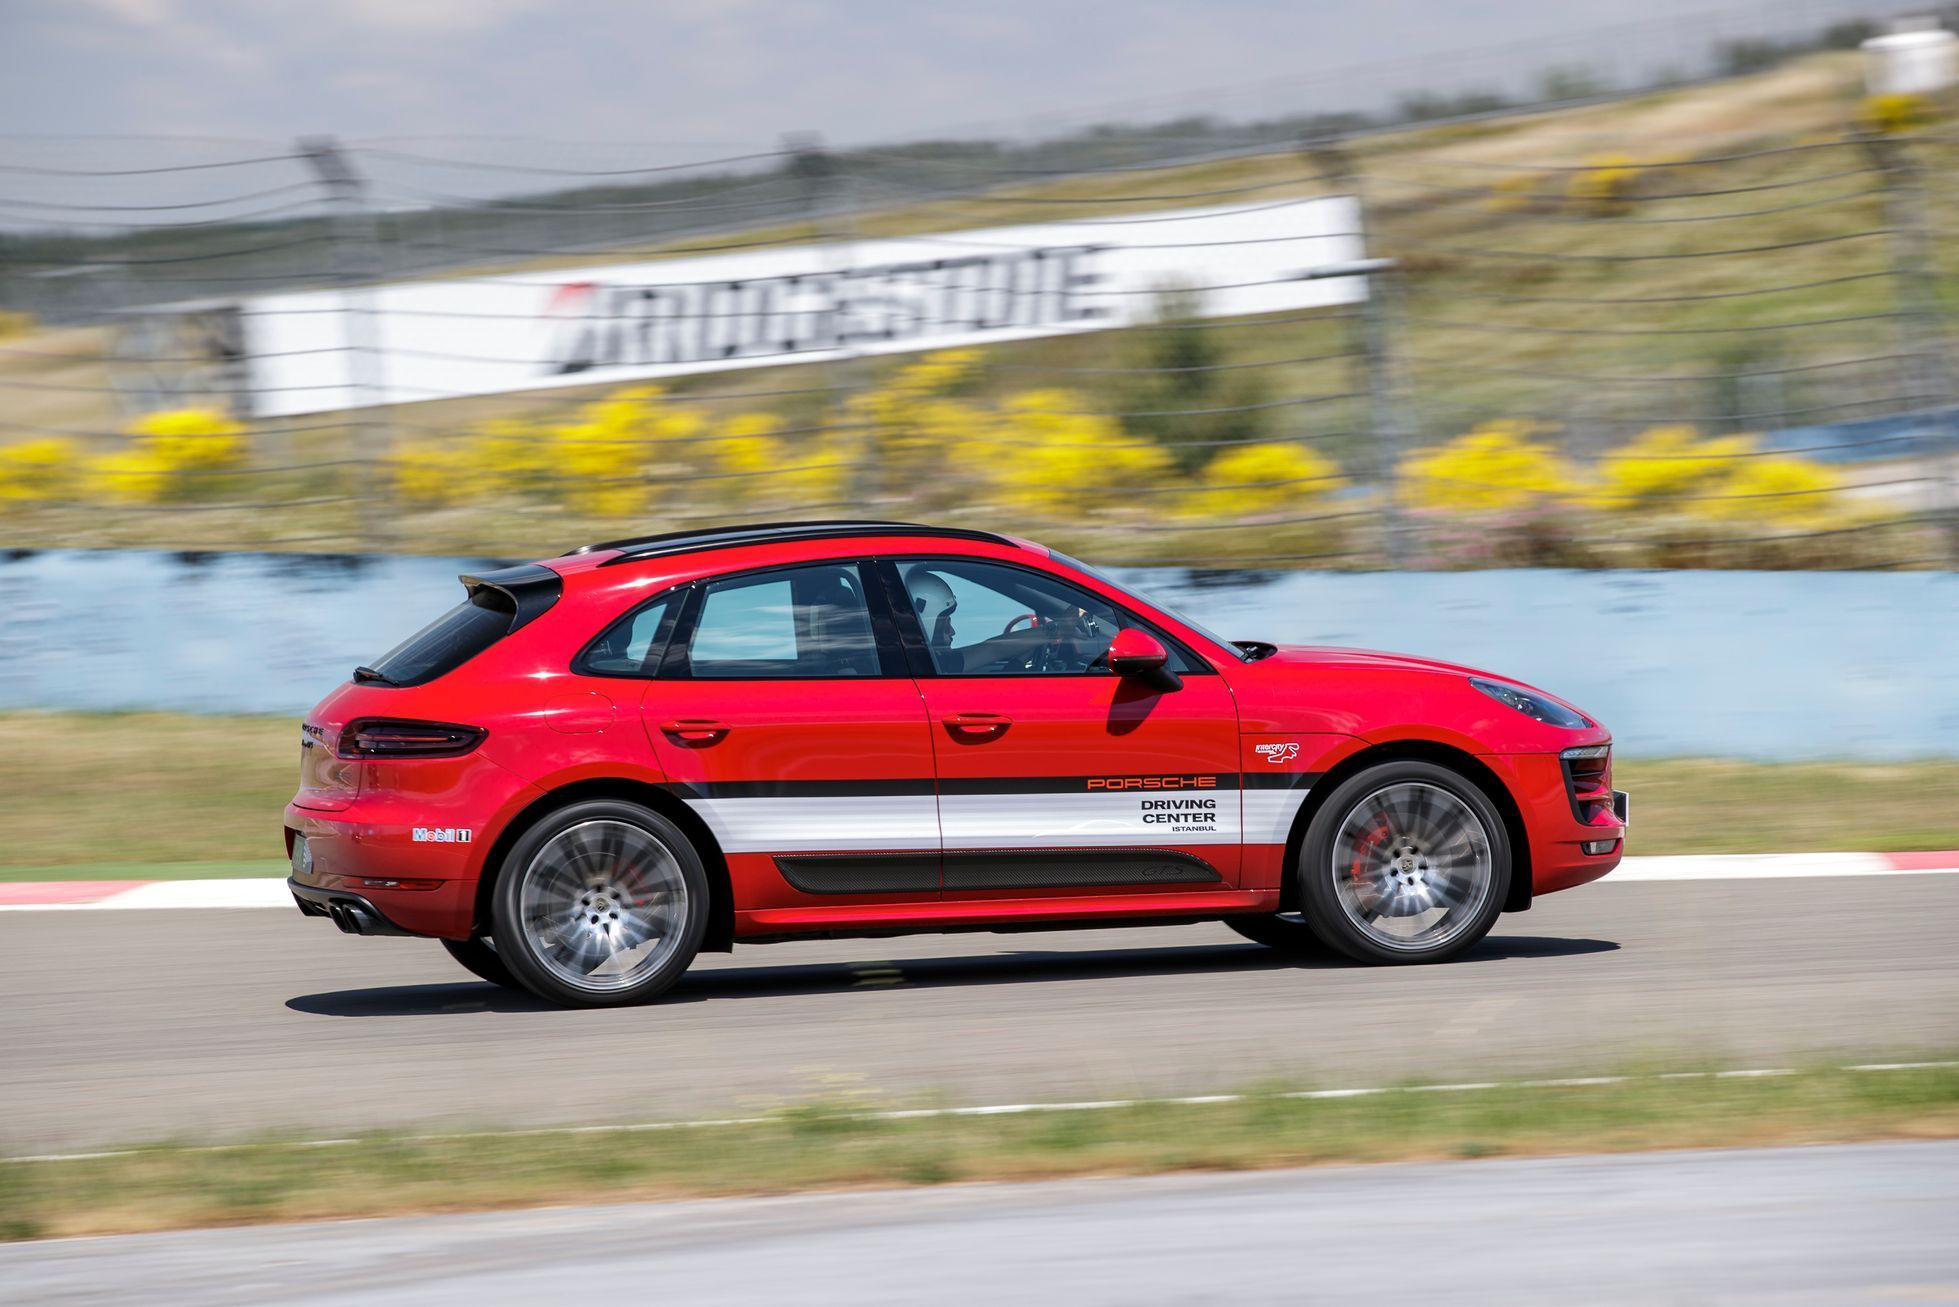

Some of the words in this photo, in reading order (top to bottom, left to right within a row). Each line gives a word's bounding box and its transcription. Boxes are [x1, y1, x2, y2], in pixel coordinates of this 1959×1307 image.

[1087, 776, 1216, 789] PORSCHE
[1141, 799, 1216, 810] DRIVING
[1142, 812, 1216, 823] CENTER
[412, 828, 455, 842] Mobil
[457, 829, 472, 842] 1
